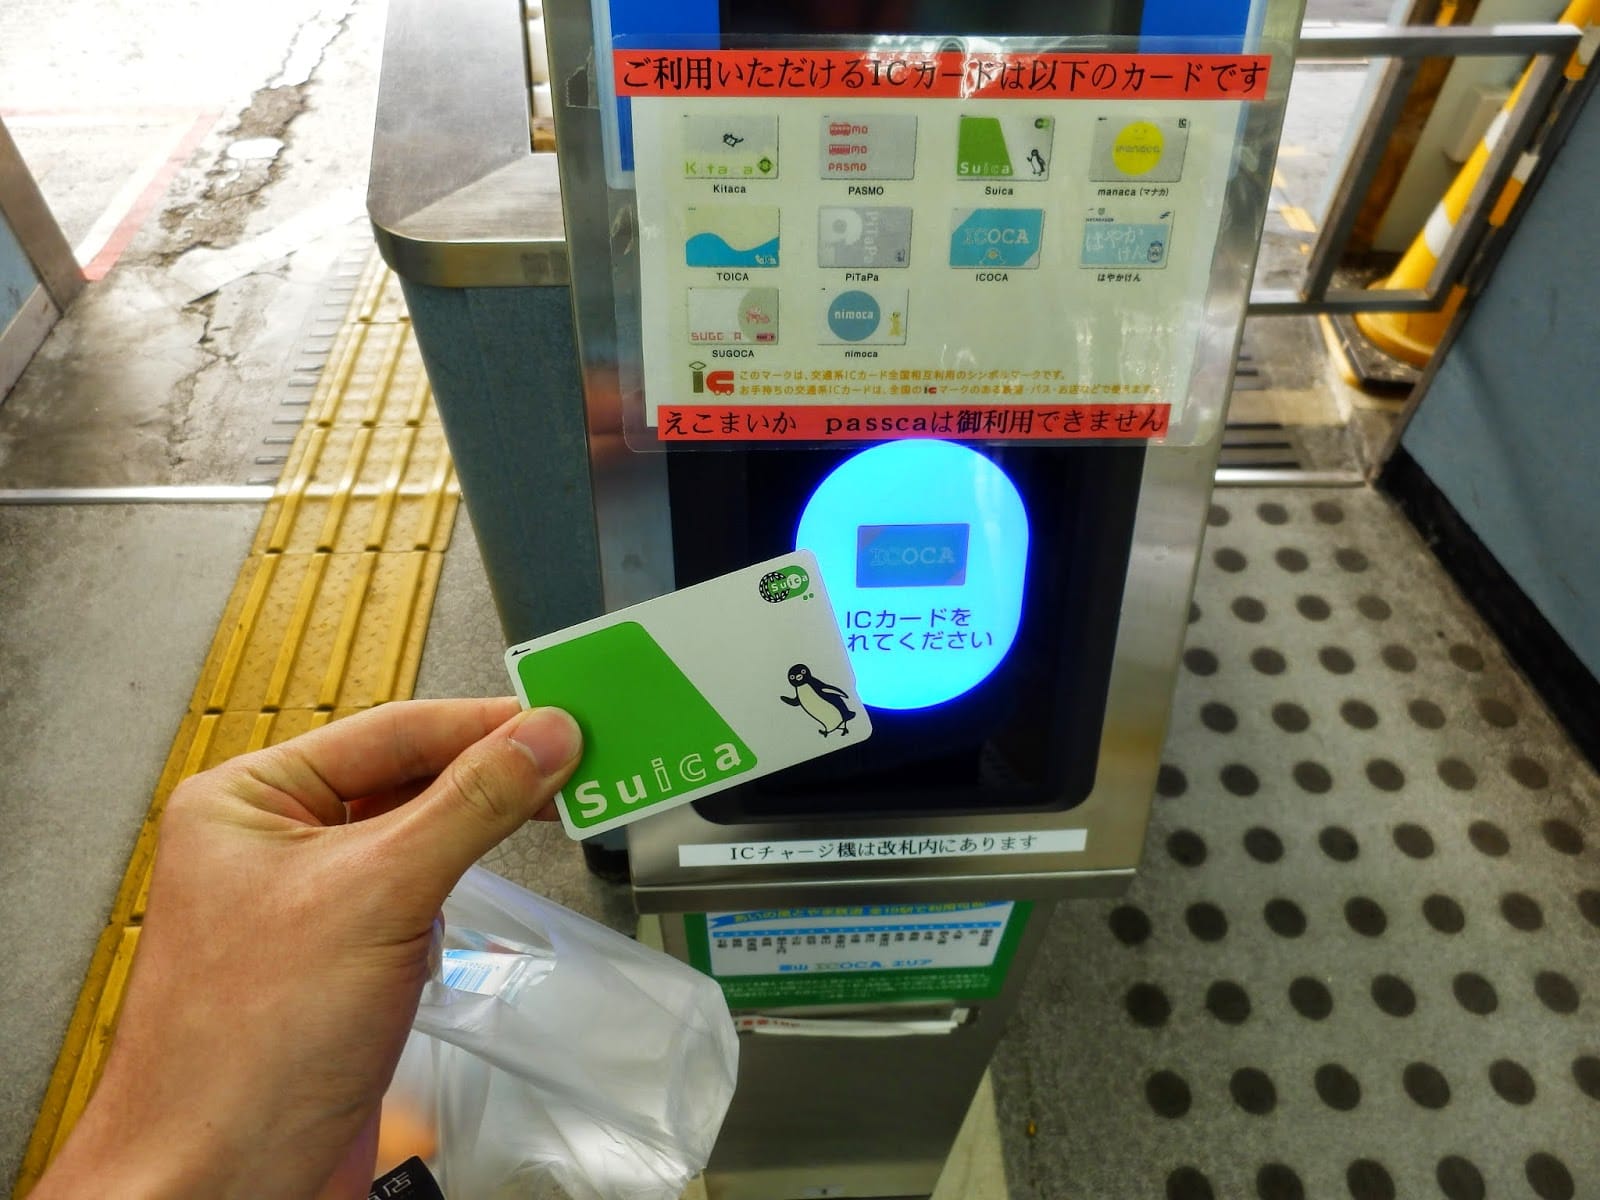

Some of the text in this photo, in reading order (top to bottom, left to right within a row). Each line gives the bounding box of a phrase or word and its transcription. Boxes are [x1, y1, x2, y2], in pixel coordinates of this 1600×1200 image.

[623, 56, 1266, 92] ご利用いただけるICカードは以下のカードです
[960, 162, 1010, 174] Suica
[713, 184, 746, 194] Kitaca
[848, 186, 884, 196] PASMO
[985, 186, 1014, 196] Suica
[1098, 188, 1136, 197] manaca
[964, 228, 1029, 246] ICOCA
[716, 272, 749, 282] TOICA
[845, 272, 879, 282] PiTaPa
[976, 273, 1009, 282] ICOCA
[1097, 273, 1142, 283] はやかけん
[834, 310, 874, 320] nimoca
[712, 349, 755, 358] SUGOCA
[845, 350, 878, 358] nimoca
[665, 409, 1163, 435] えこまいか passcaは御利用できません
[870, 547, 955, 567] ICOCA
[771, 575, 808, 592] Suica
[846, 608, 971, 629] ICカードを
[575, 742, 742, 819] Suica
[730, 835, 1038, 861] ICチャージ機は改札内にあります
